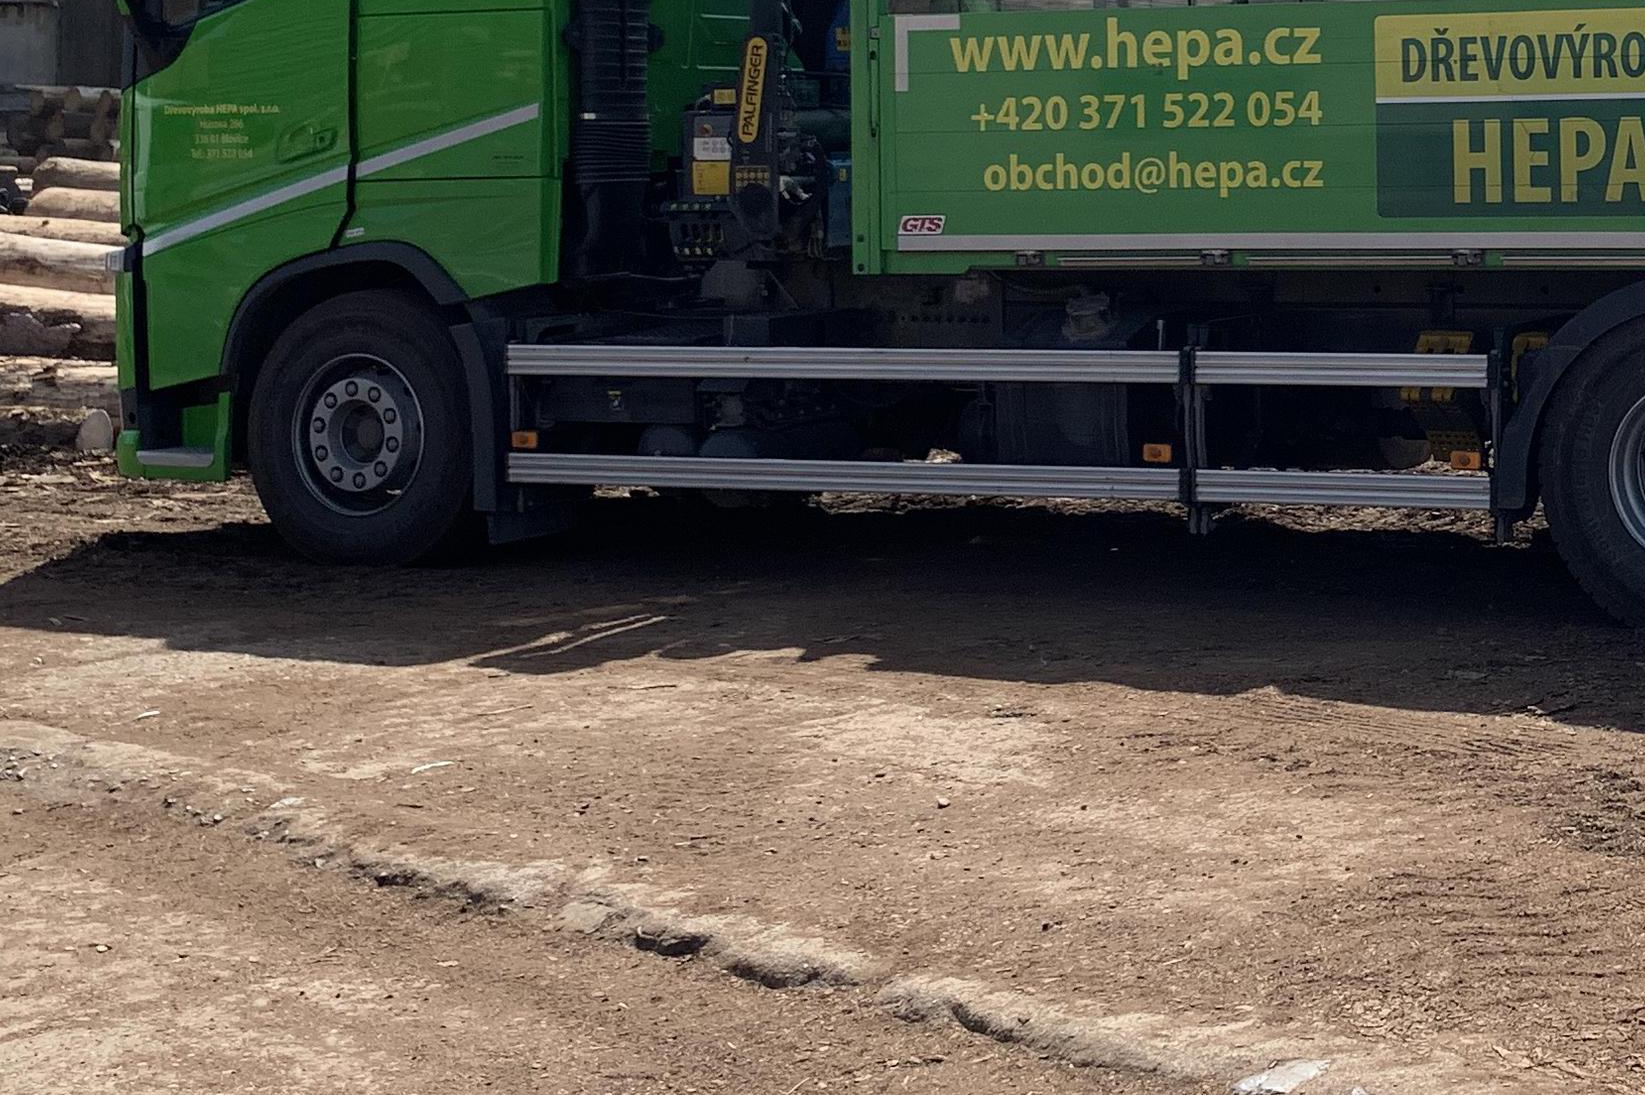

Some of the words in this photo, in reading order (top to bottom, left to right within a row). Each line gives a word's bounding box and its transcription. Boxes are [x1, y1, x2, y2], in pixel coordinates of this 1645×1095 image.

[949, 17, 1322, 81] www.hepa.cz
[742, 43, 764, 137] PALFINGER
[970, 95, 1068, 132] +420
[1078, 94, 1145, 130] 371
[1162, 92, 1235, 128] 522
[1247, 90, 1323, 127] 054
[983, 150, 1324, 198] obchod@hepa.cz
[902, 217, 943, 232] GTS
